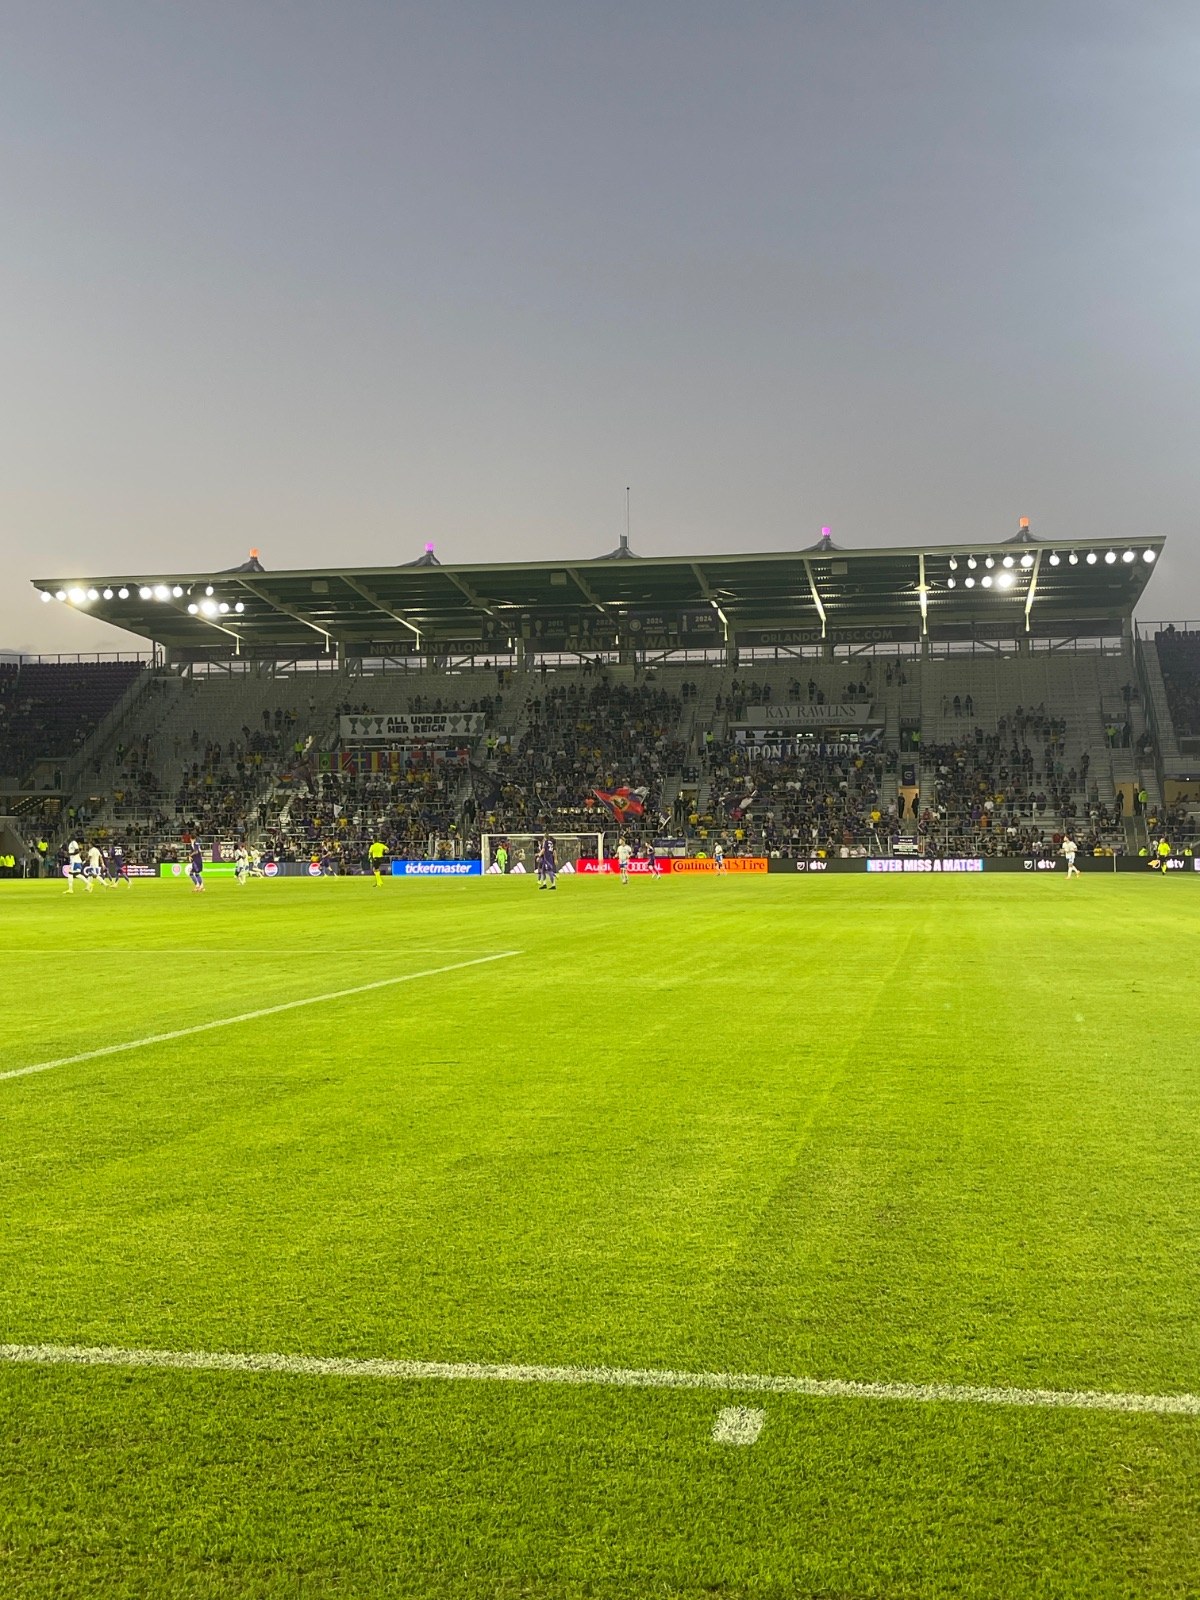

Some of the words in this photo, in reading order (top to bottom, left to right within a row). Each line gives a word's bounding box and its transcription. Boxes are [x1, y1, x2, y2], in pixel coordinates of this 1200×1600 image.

[760, 630, 893, 643] ORLANDOITYSC.COM
[370, 645, 408, 655] NEVER
[448, 643, 489, 653] ALONE
[564, 638, 603, 651] MAN
[645, 635, 684, 648] WALL
[765, 705, 793, 718] KAY
[797, 704, 857, 718] RAWLINS
[387, 716, 406, 725] ALL
[410, 715, 447, 725] UNDER
[387, 725, 409, 734] HER
[413, 724, 446, 734] REIGN
[114, 848, 123, 856] 20
[404, 862, 472, 874] ticketmaster
[584, 862, 612, 872] Audi
[672, 859, 731, 873] Continenal
[740, 859, 765, 870] Tire
[868, 859, 902, 872] NEVER
[903, 859, 932, 872] MISS
[933, 859, 942, 872] A
[943, 859, 981, 872] MATCH
